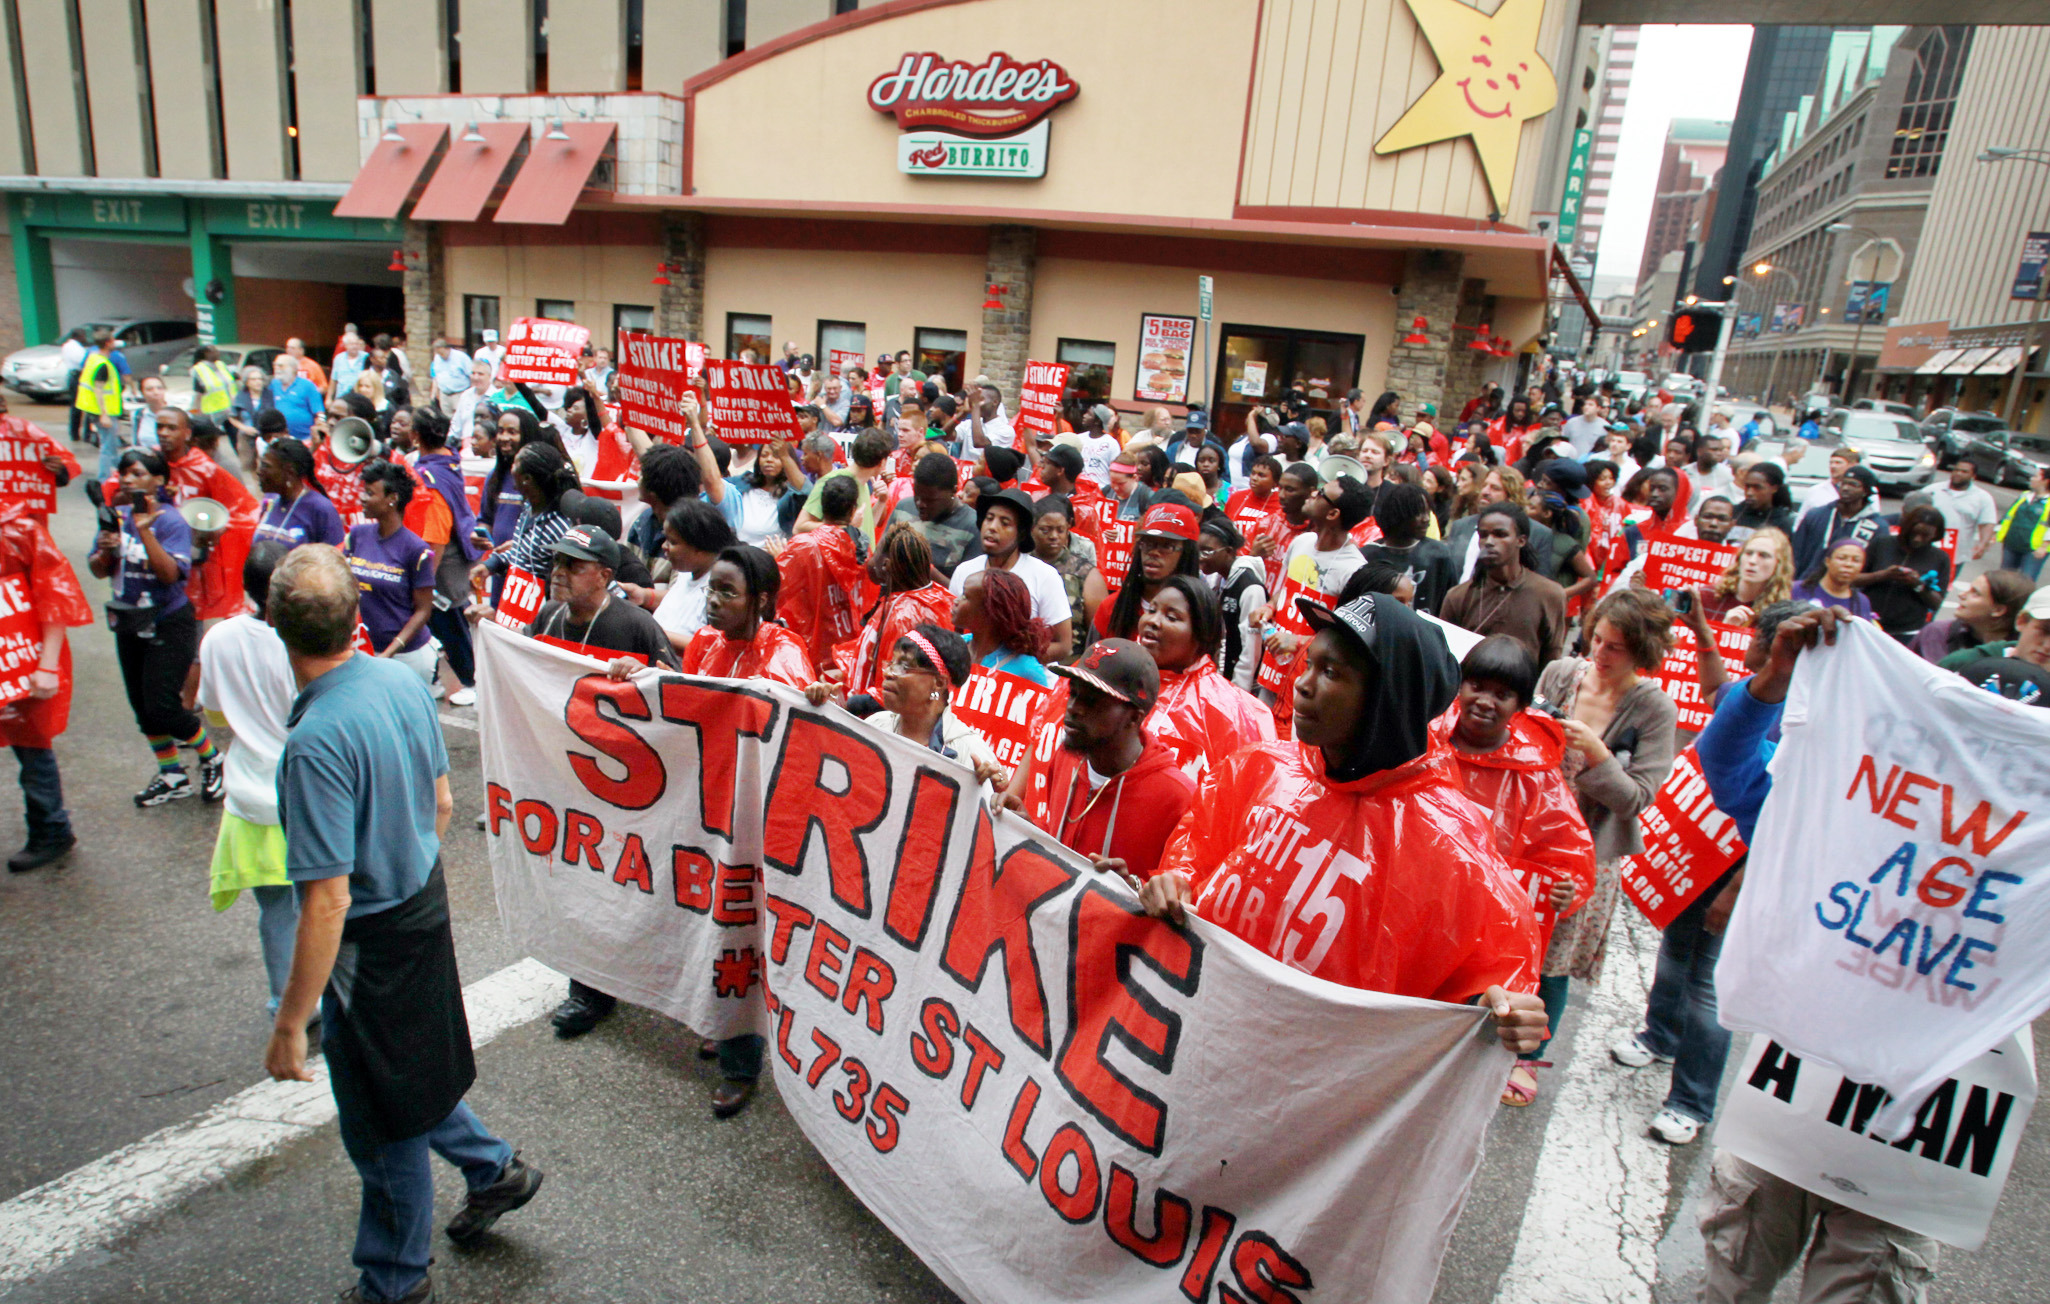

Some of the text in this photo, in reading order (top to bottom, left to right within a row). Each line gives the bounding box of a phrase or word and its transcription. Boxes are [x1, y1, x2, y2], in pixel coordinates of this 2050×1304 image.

[871, 56, 1070, 106] Hardee's
[909, 140, 1029, 168] Red BURRITO
[1564, 132, 1589, 214] PARK
[93, 200, 142, 223] EXIT
[247, 203, 304, 229] EXIT
[530, 323, 589, 345] STRIKE
[1161, 329, 1190, 339] BAG
[1162, 320, 1191, 330] BIG
[628, 340, 683, 371] STRIKE
[708, 366, 785, 391] ON STRIKE
[1029, 365, 1066, 388] STRIKE
[713, 407, 744, 422] BETTER
[762, 412, 793, 424] LOUIS
[0, 440, 50, 462] RIKE
[1650, 540, 1711, 564] RESPECT
[1344, 613, 1367, 633] Group
[1846, 754, 2030, 859] NEW
[1868, 841, 2024, 924] AGE
[564, 672, 1206, 1158] STRIKE
[1814, 880, 1998, 992] SLAVE
[486, 781, 1315, 1304] FOR A BETER ST LOUIS
[1747, 1038, 2016, 1179] A MAN
